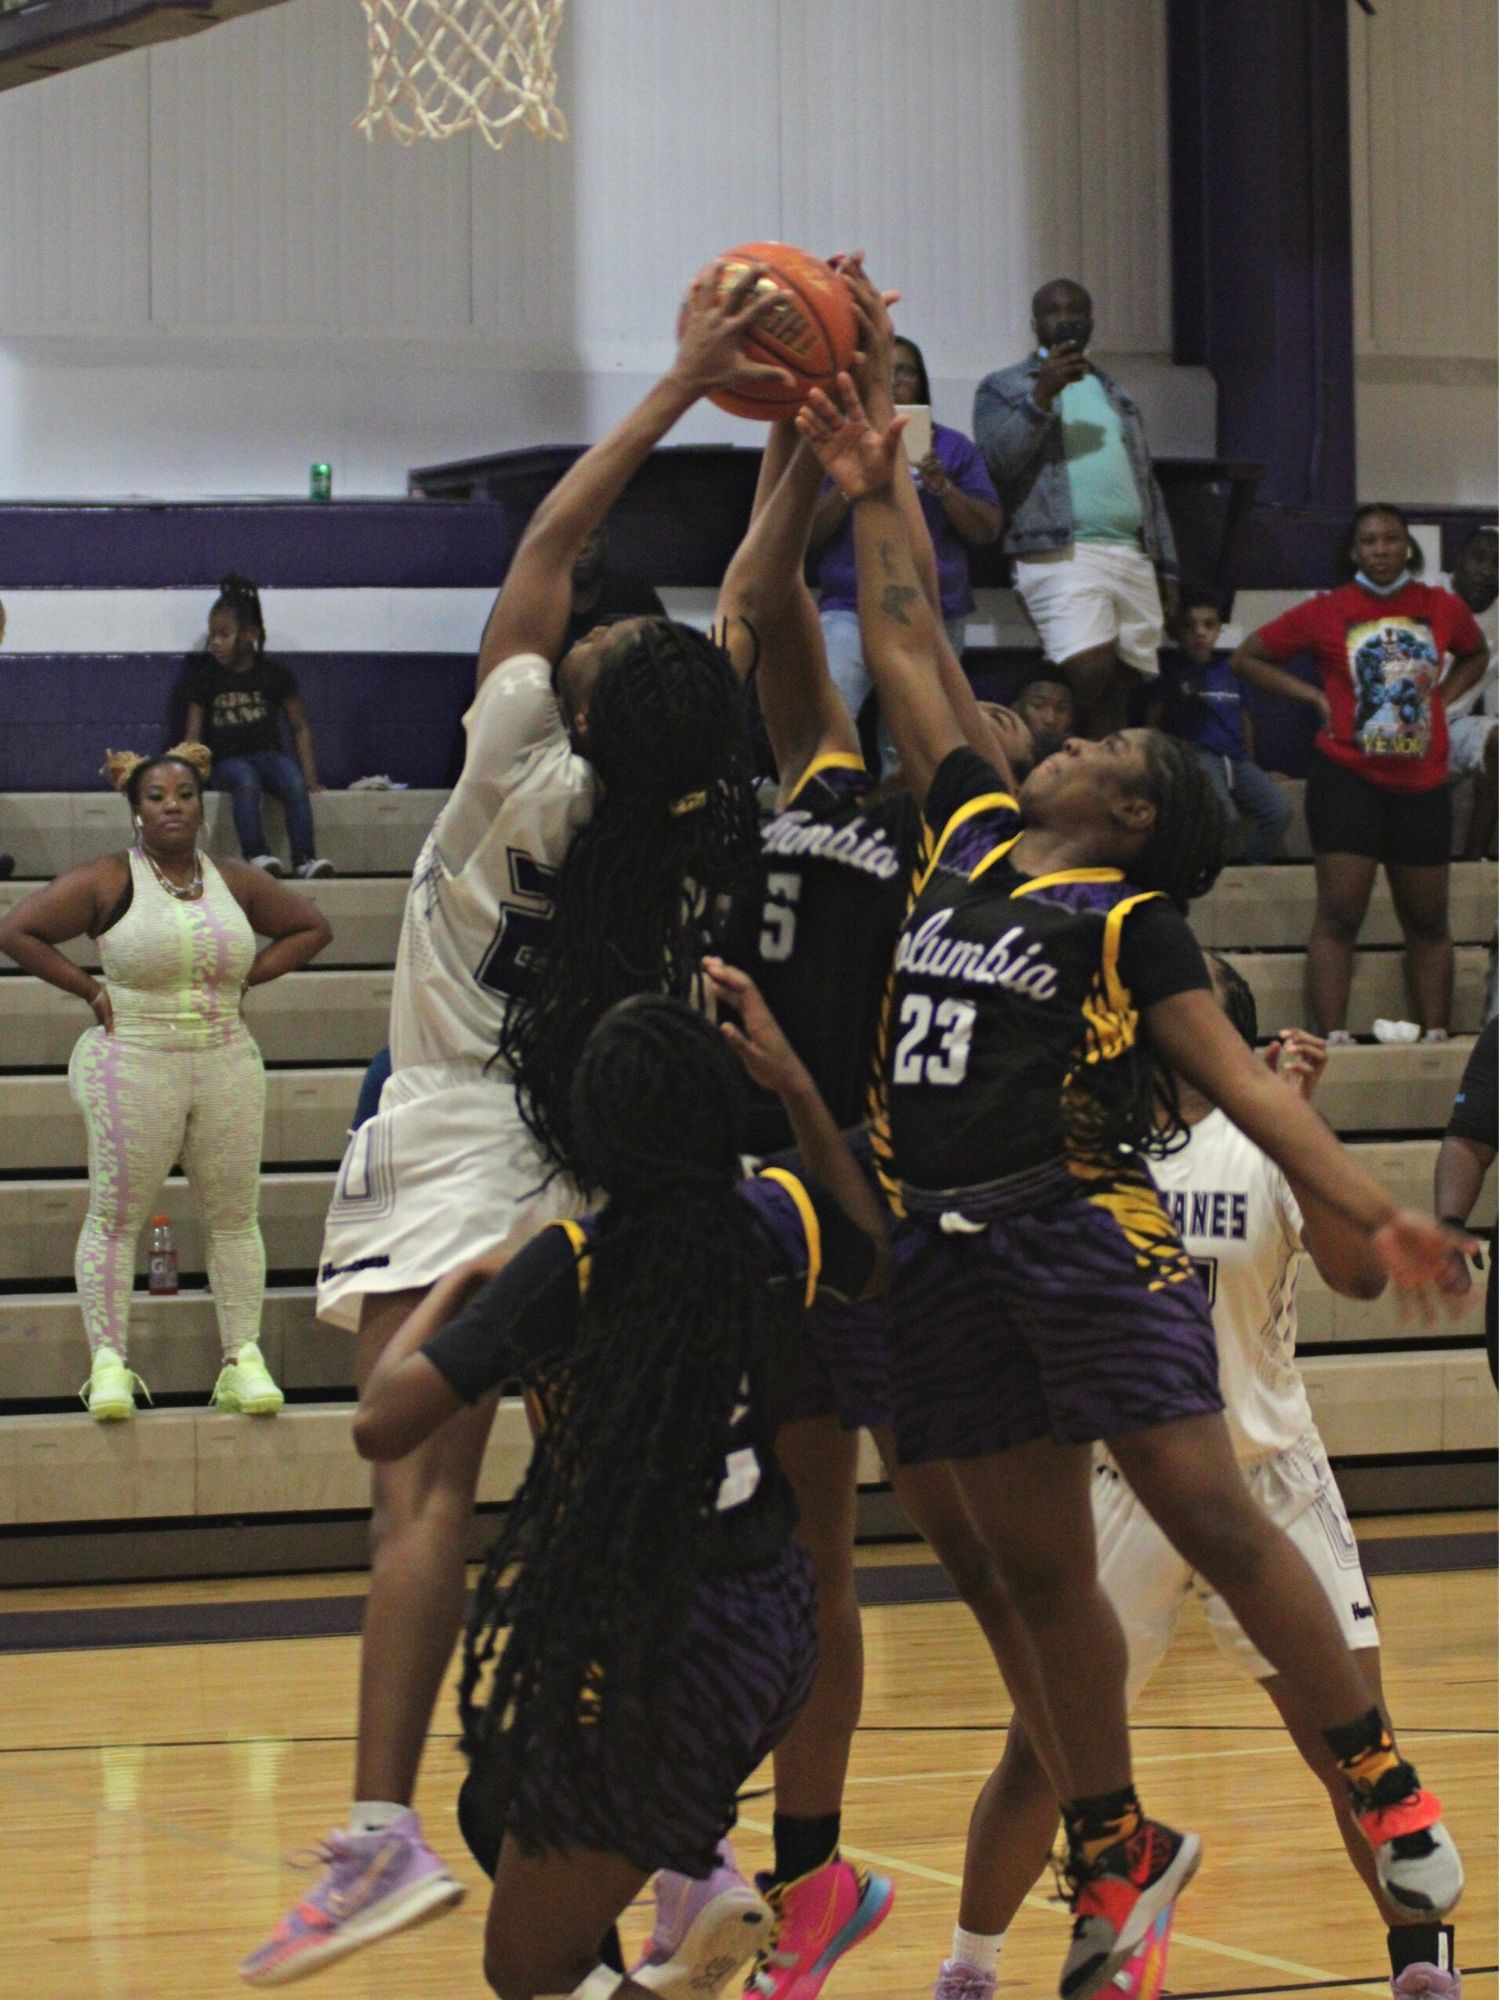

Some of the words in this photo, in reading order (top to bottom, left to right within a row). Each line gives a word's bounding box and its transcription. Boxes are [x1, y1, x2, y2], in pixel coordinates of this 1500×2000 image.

[761, 810, 899, 879] lumbia
[760, 873, 800, 961] 5
[896, 908, 1057, 1000] lumbia
[894, 994, 976, 1085] 23
